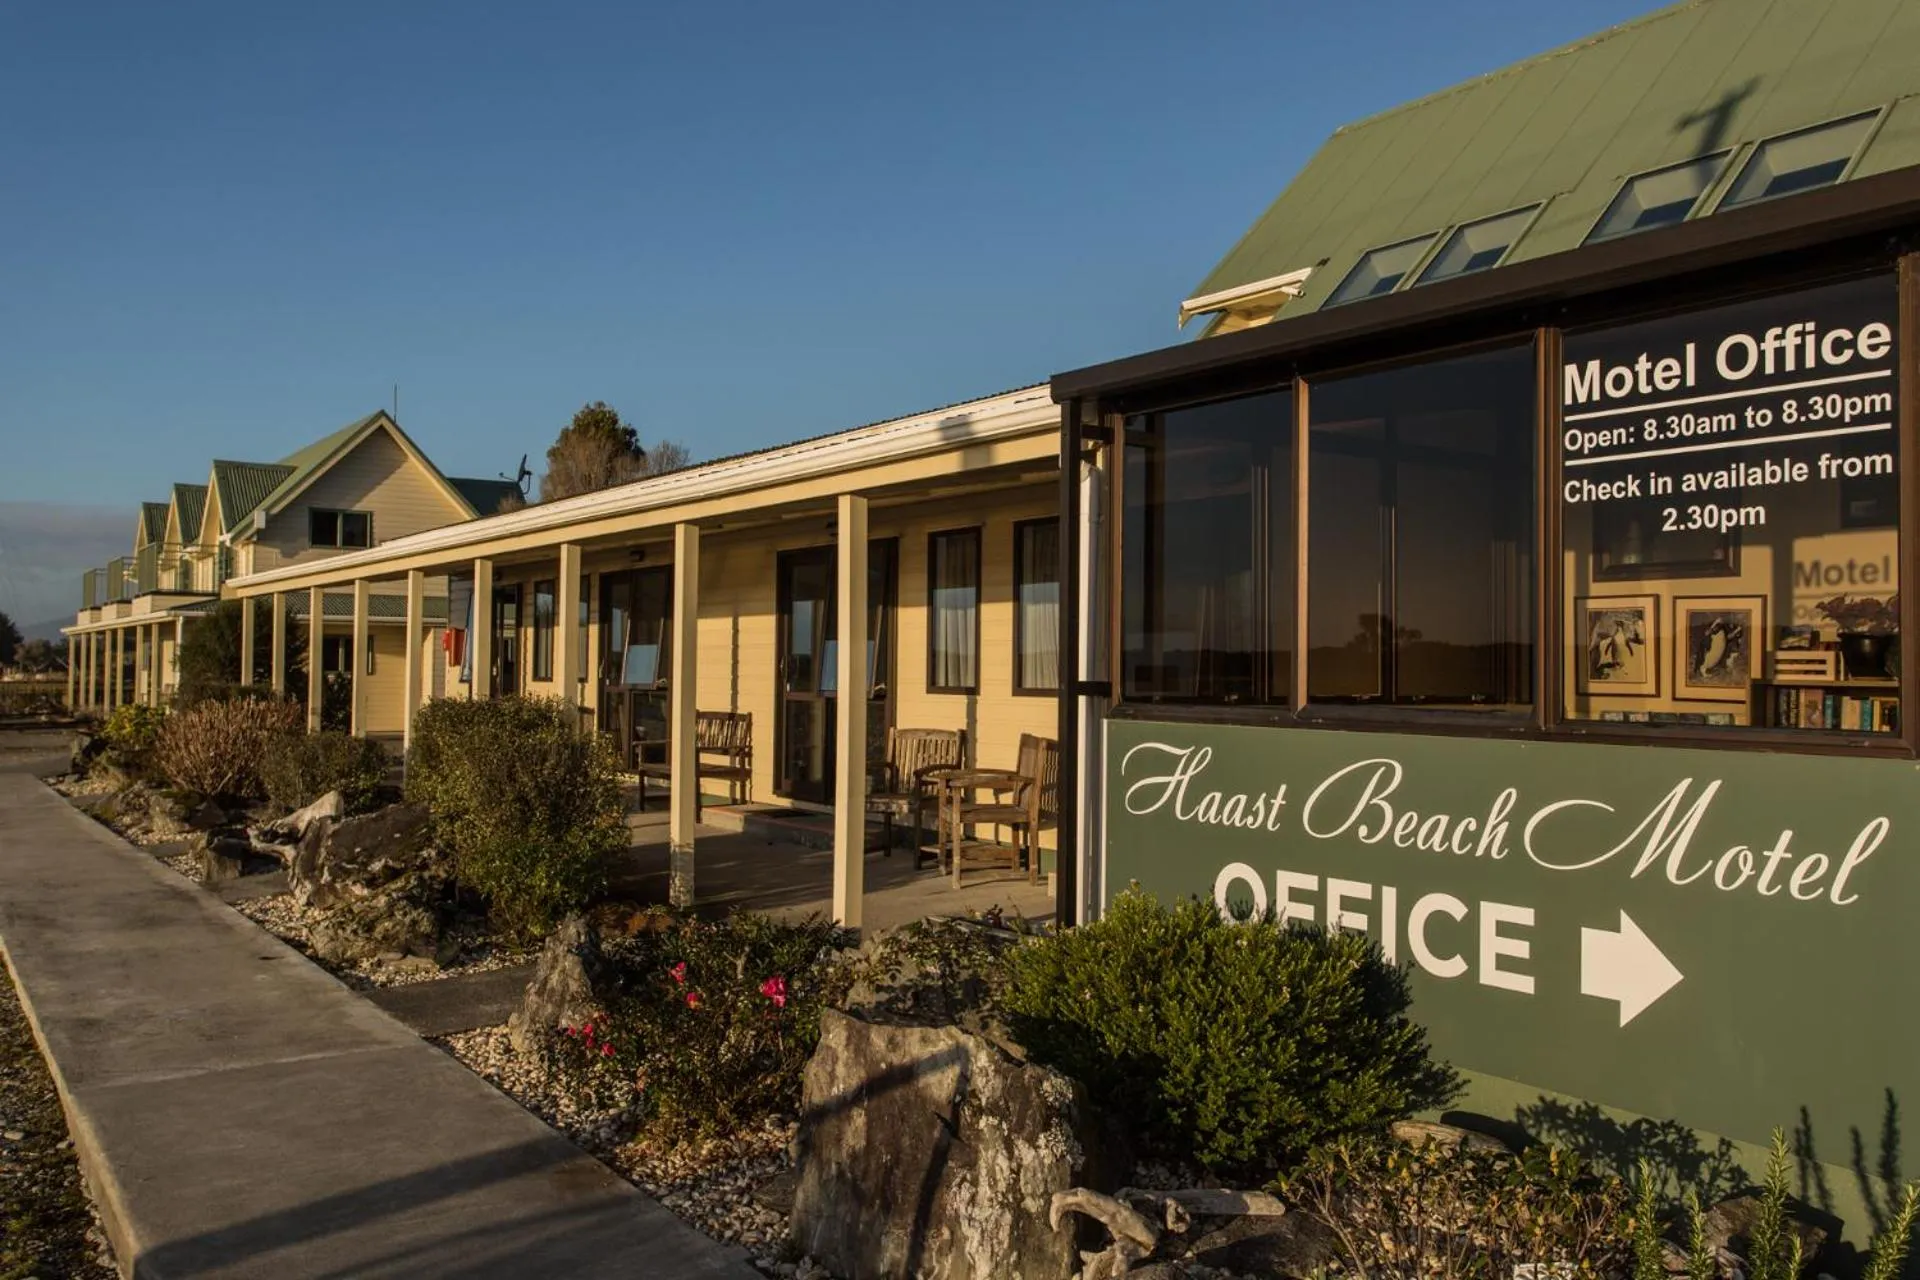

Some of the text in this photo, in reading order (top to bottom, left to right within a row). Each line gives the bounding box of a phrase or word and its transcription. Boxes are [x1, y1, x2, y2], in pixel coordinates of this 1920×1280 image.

[1564, 321, 1892, 406] Motel Office
[1564, 392, 1892, 455] Open: 8.30am to 8.30pm
[1564, 452, 1893, 504] Check in available from
[1661, 503, 1766, 534] 2.30pm
[1794, 554, 1891, 588] Motel
[1121, 741, 1891, 906] Haast Beach Motel
[1213, 861, 1536, 995] OFFICE
